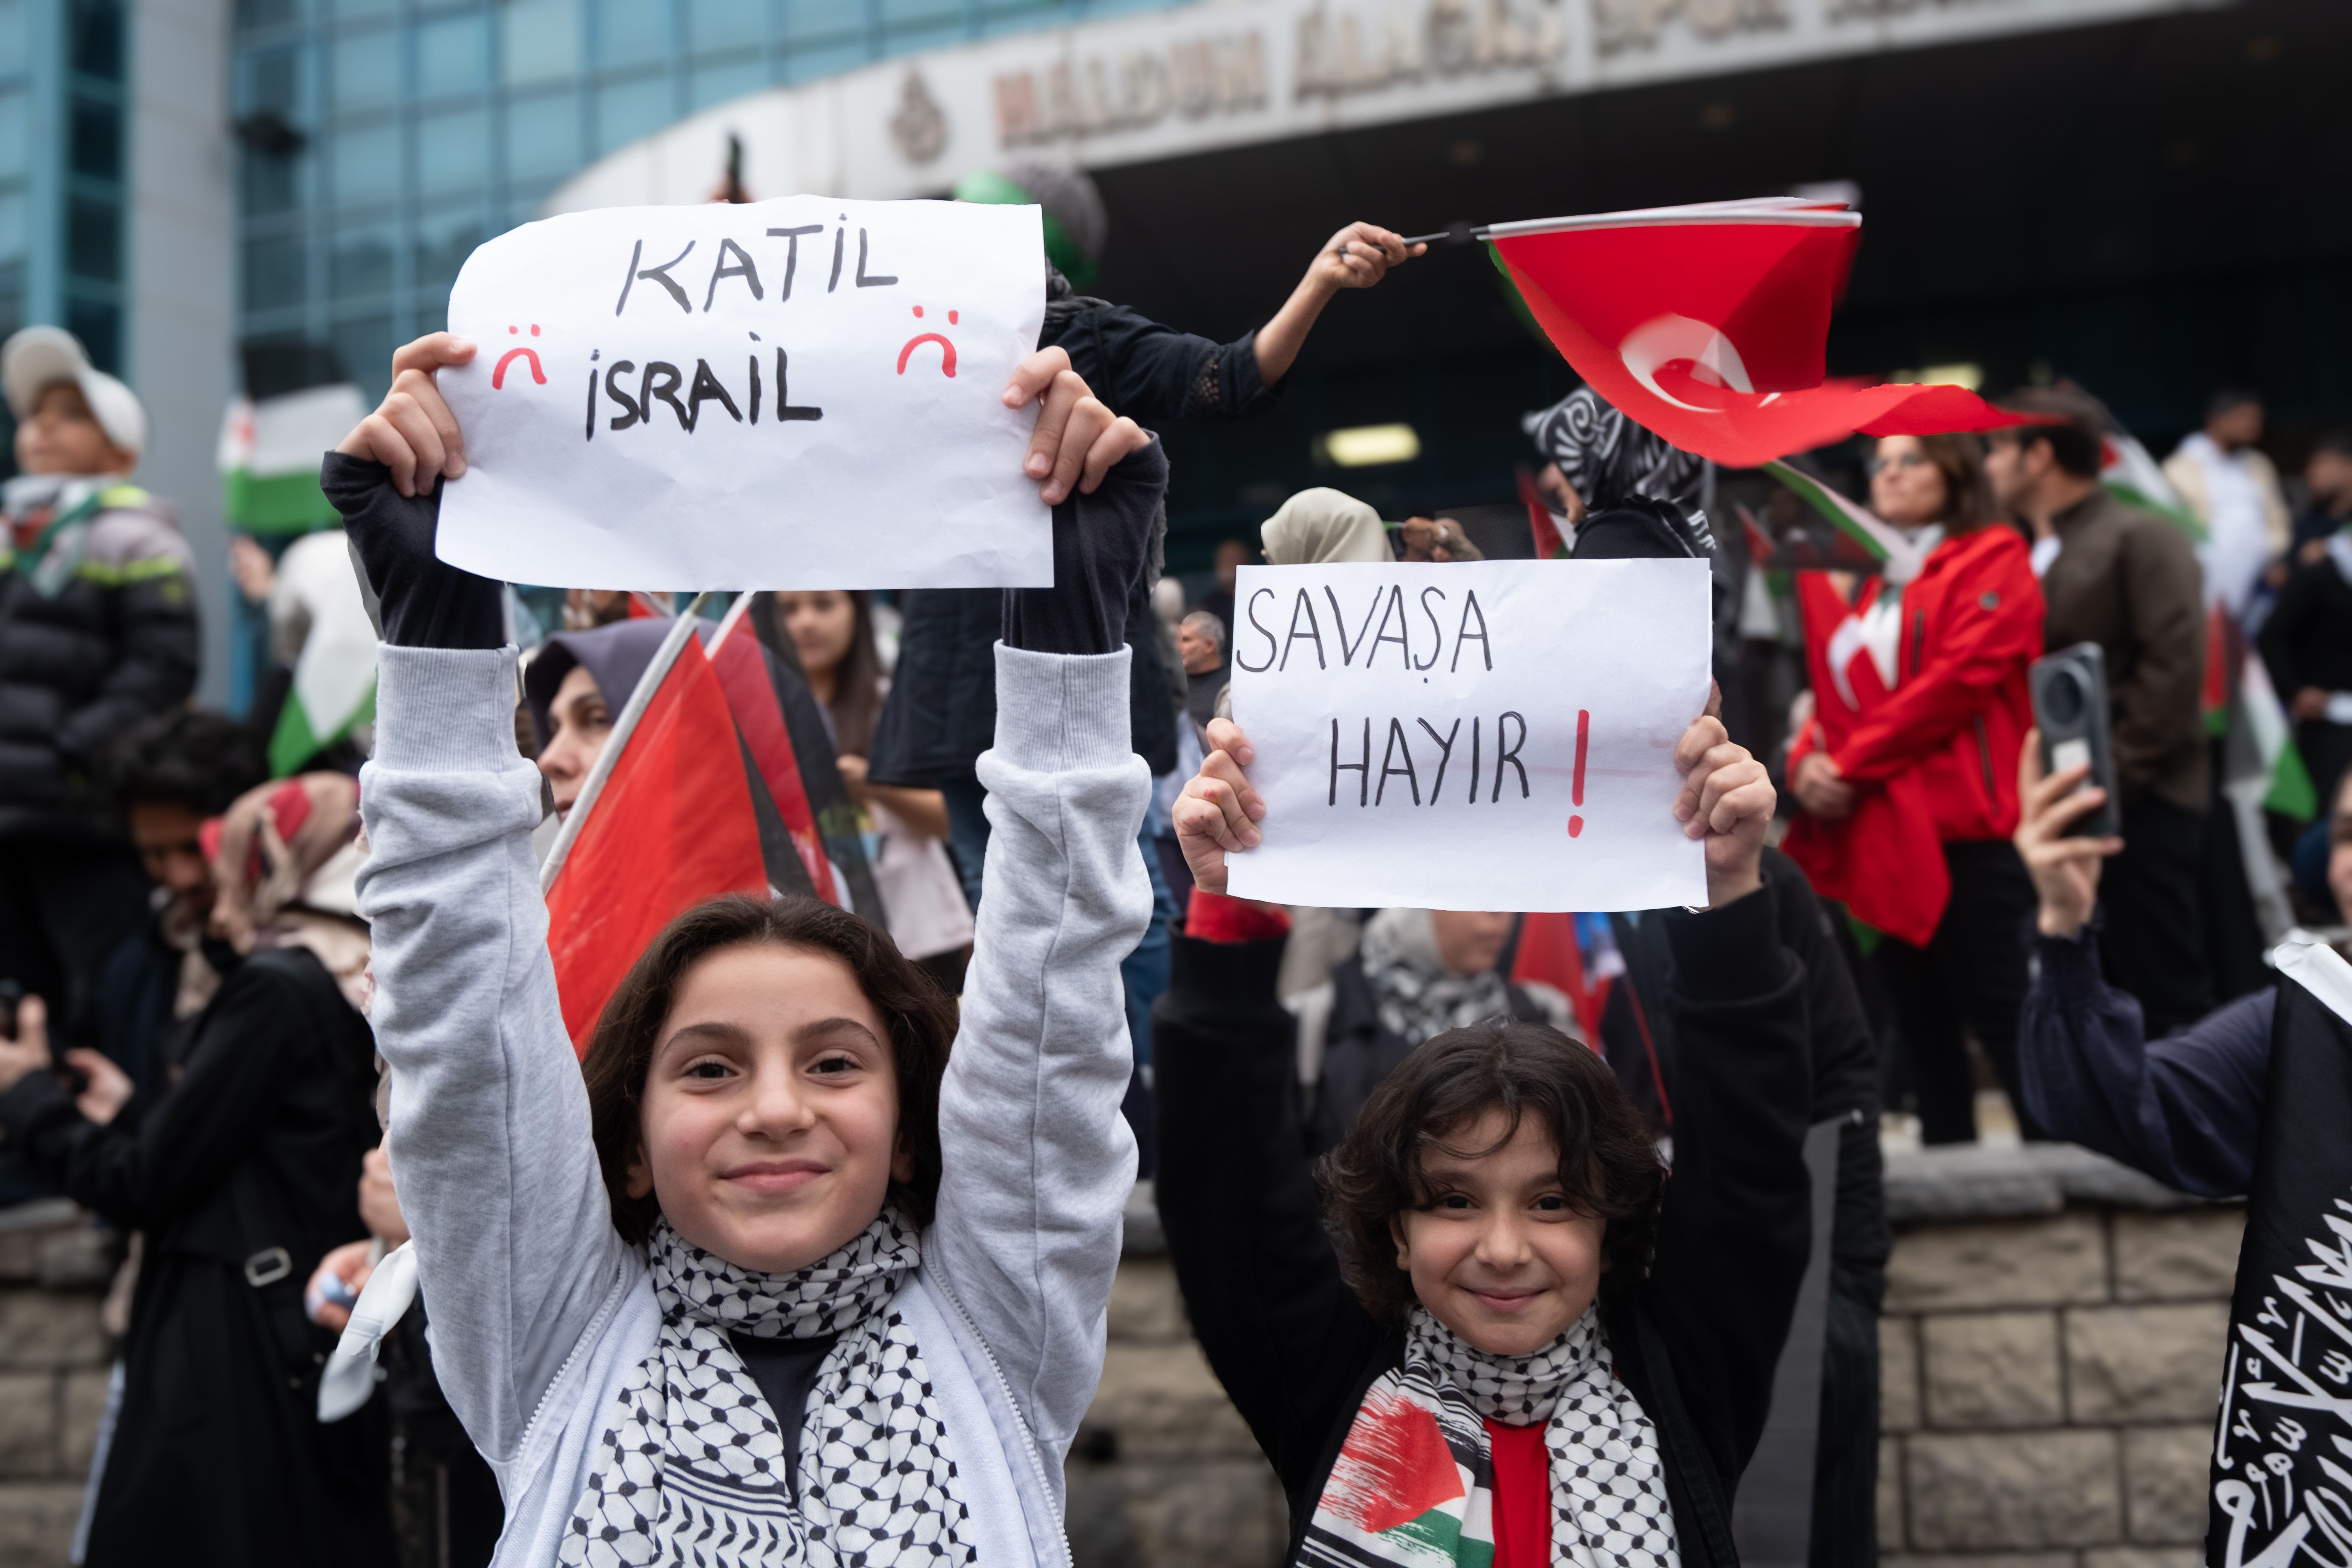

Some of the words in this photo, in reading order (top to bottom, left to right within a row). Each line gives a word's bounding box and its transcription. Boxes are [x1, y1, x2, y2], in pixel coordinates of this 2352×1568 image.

[616, 213, 899, 316] KATİL
[586, 332, 824, 441] İSRAİL
[1236, 584, 1493, 684] SAVAŞA
[1328, 711, 1530, 808] HAYIR
